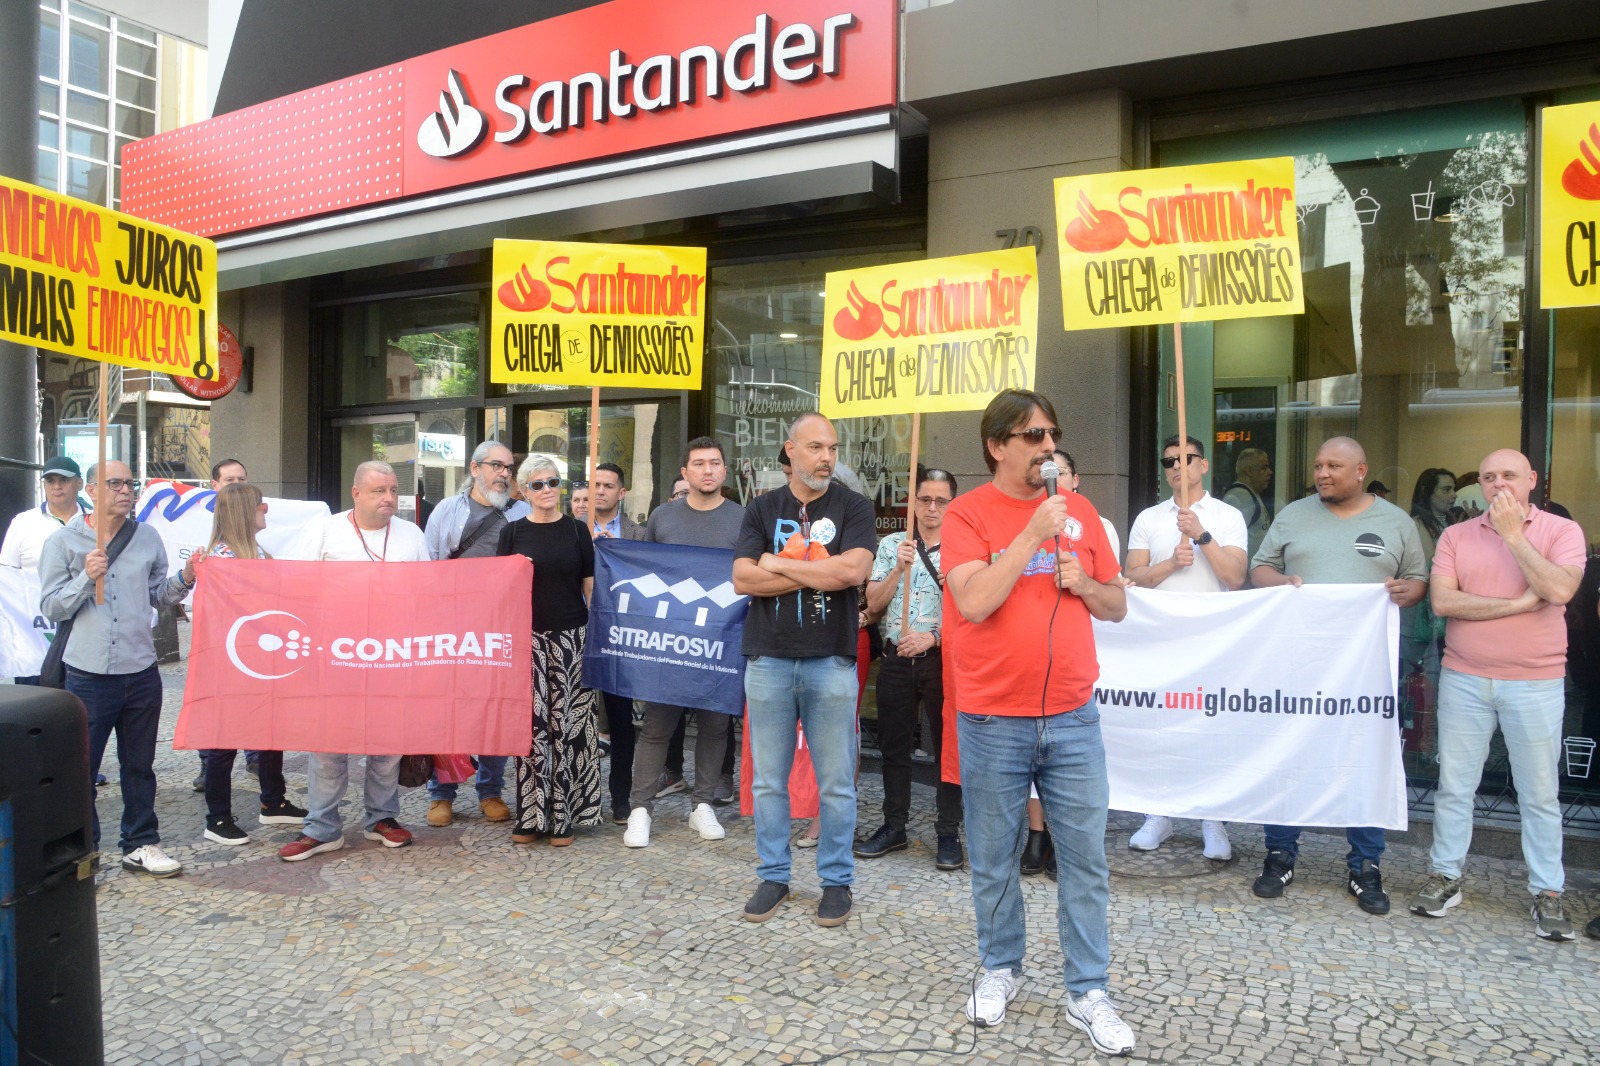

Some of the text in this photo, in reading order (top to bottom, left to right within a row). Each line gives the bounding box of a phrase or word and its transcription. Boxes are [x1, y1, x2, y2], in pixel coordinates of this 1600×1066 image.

[494, 13, 855, 144] Santander
[1118, 179, 1293, 249] Santander
[0, 185, 203, 305] MENOS JUROS
[545, 256, 705, 317] Santander
[1085, 243, 1294, 317] CHEGA de DEMISSÕES
[0, 263, 75, 346] MAIS
[881, 269, 1032, 339] Santander
[504, 321, 694, 376] CHEGA DE DEMISSÕES
[834, 331, 1029, 404] CHEGA de DEMISSÕES
[180, 376, 238, 396] OLLAR WITHDRAWAL
[736, 389, 814, 415] velkommen
[735, 414, 911, 447] BIENNIDO
[735, 456, 783, 472] ласкав
[331, 632, 503, 661] CONTRAF
[331, 660, 373, 669] Confederação
[608, 626, 724, 660] SITRAFOSVI
[666, 658, 684, 666] Fondo
[684, 660, 702, 669] Social
[1093, 686, 1395, 719] www.uniglobalunion.org
